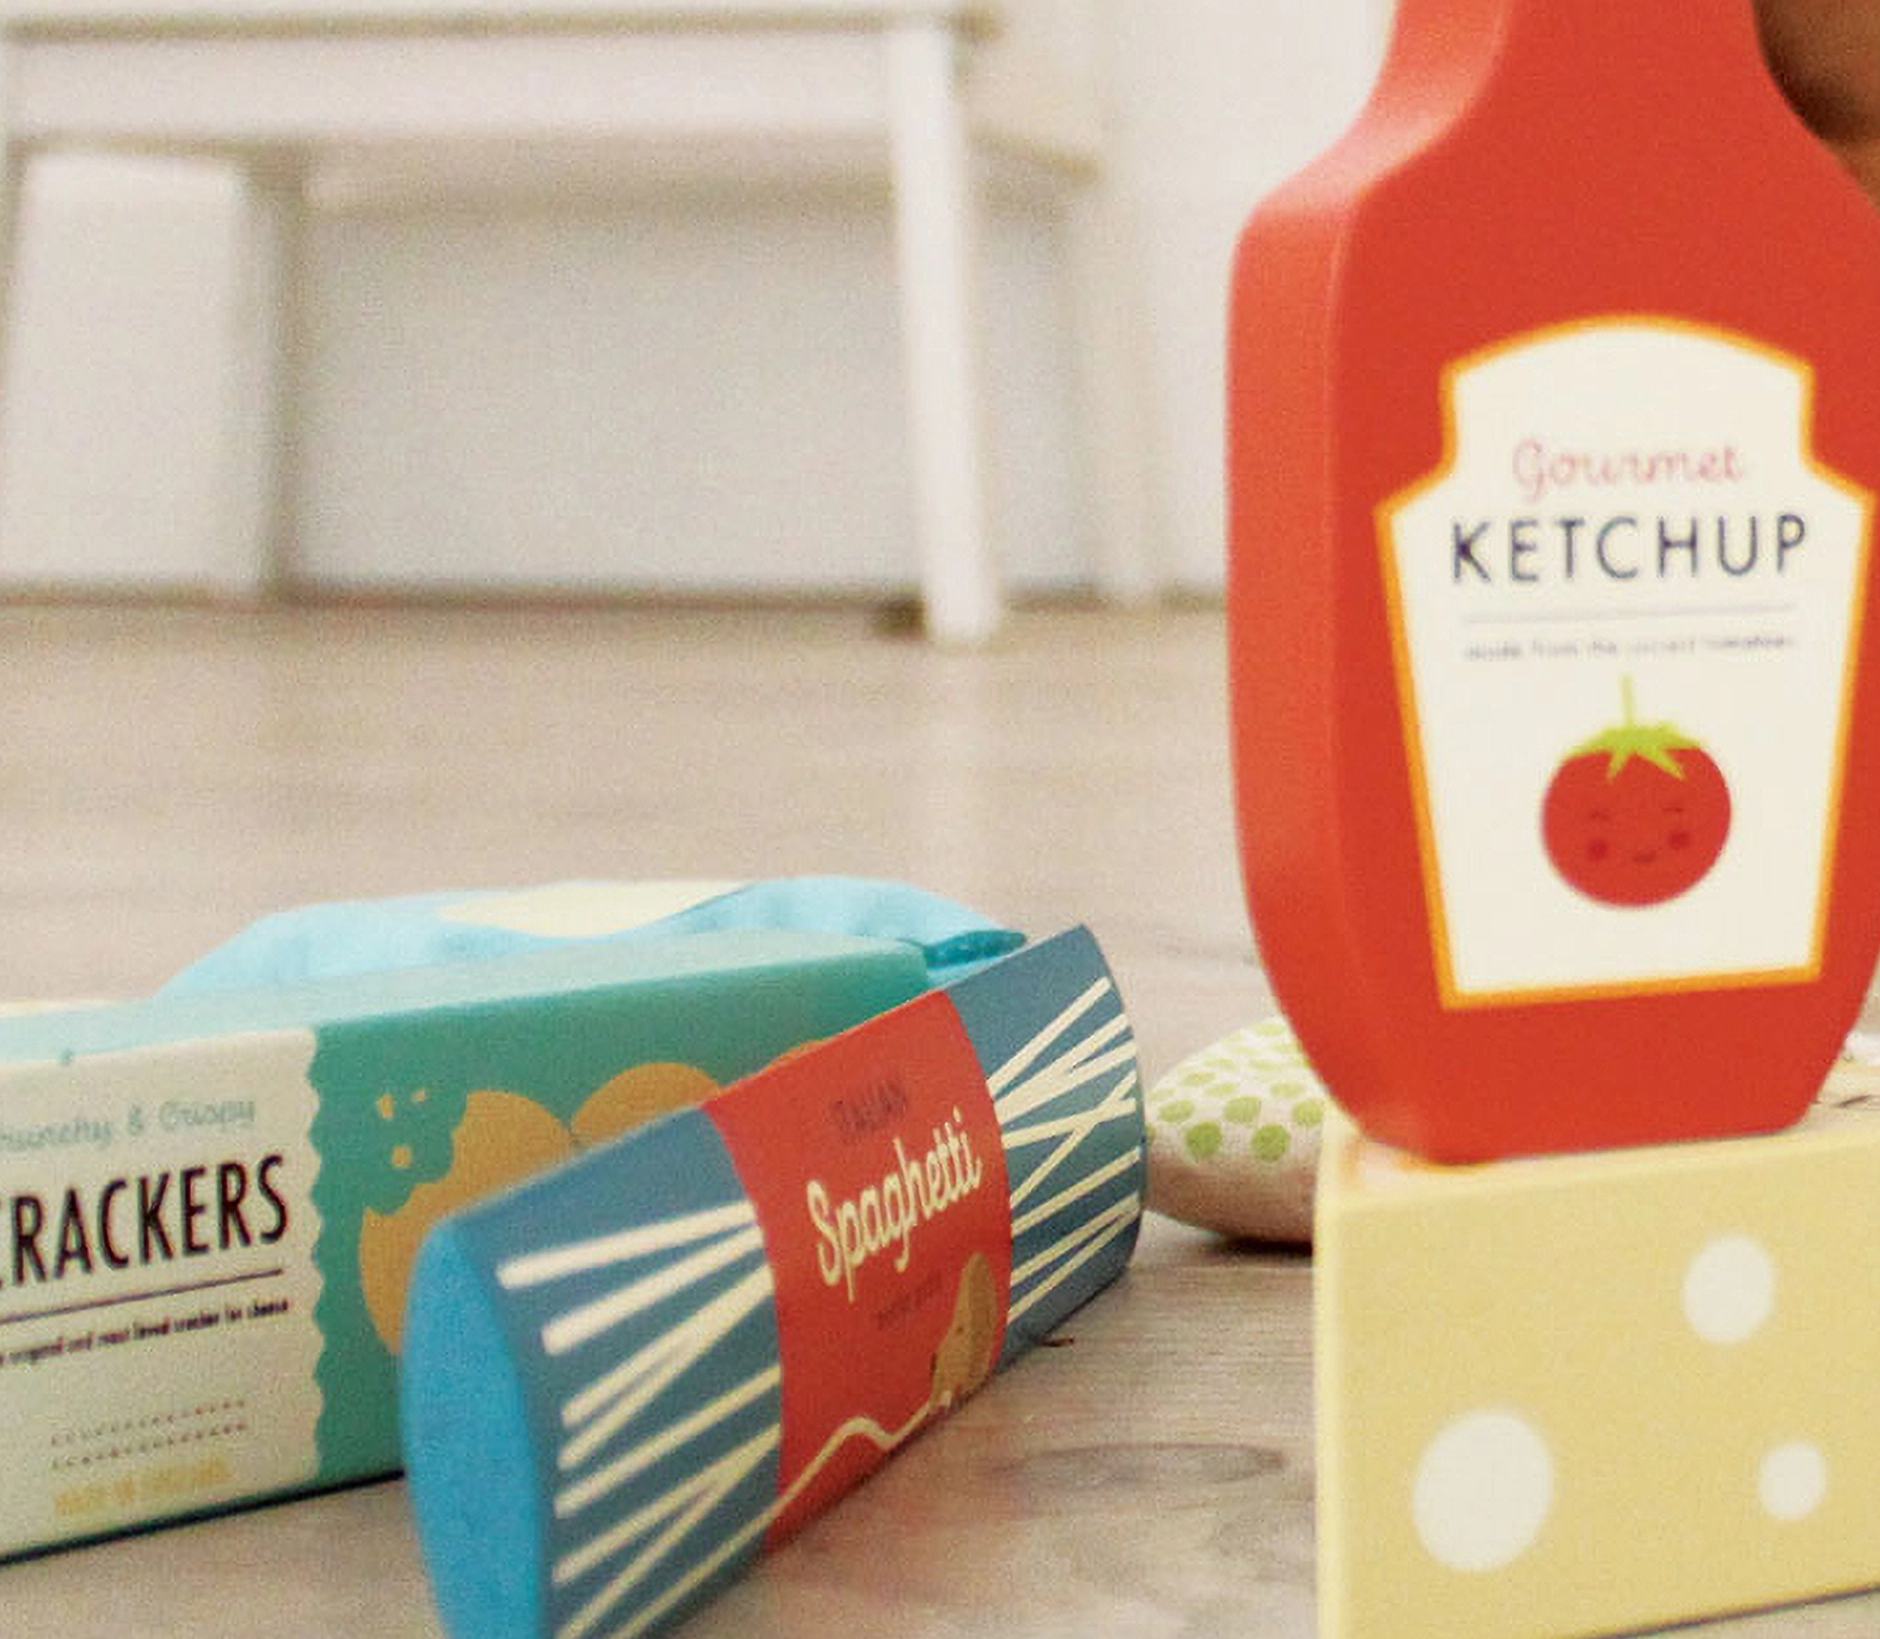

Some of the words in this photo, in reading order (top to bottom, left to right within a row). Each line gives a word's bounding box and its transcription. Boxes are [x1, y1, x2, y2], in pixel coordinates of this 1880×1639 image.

[1511, 437, 1743, 503] Gourmet
[1450, 512, 1806, 583] KETCHUP
[0, 1155, 287, 1287] RACKERS
[807, 1106, 984, 1303] Spaghetti
